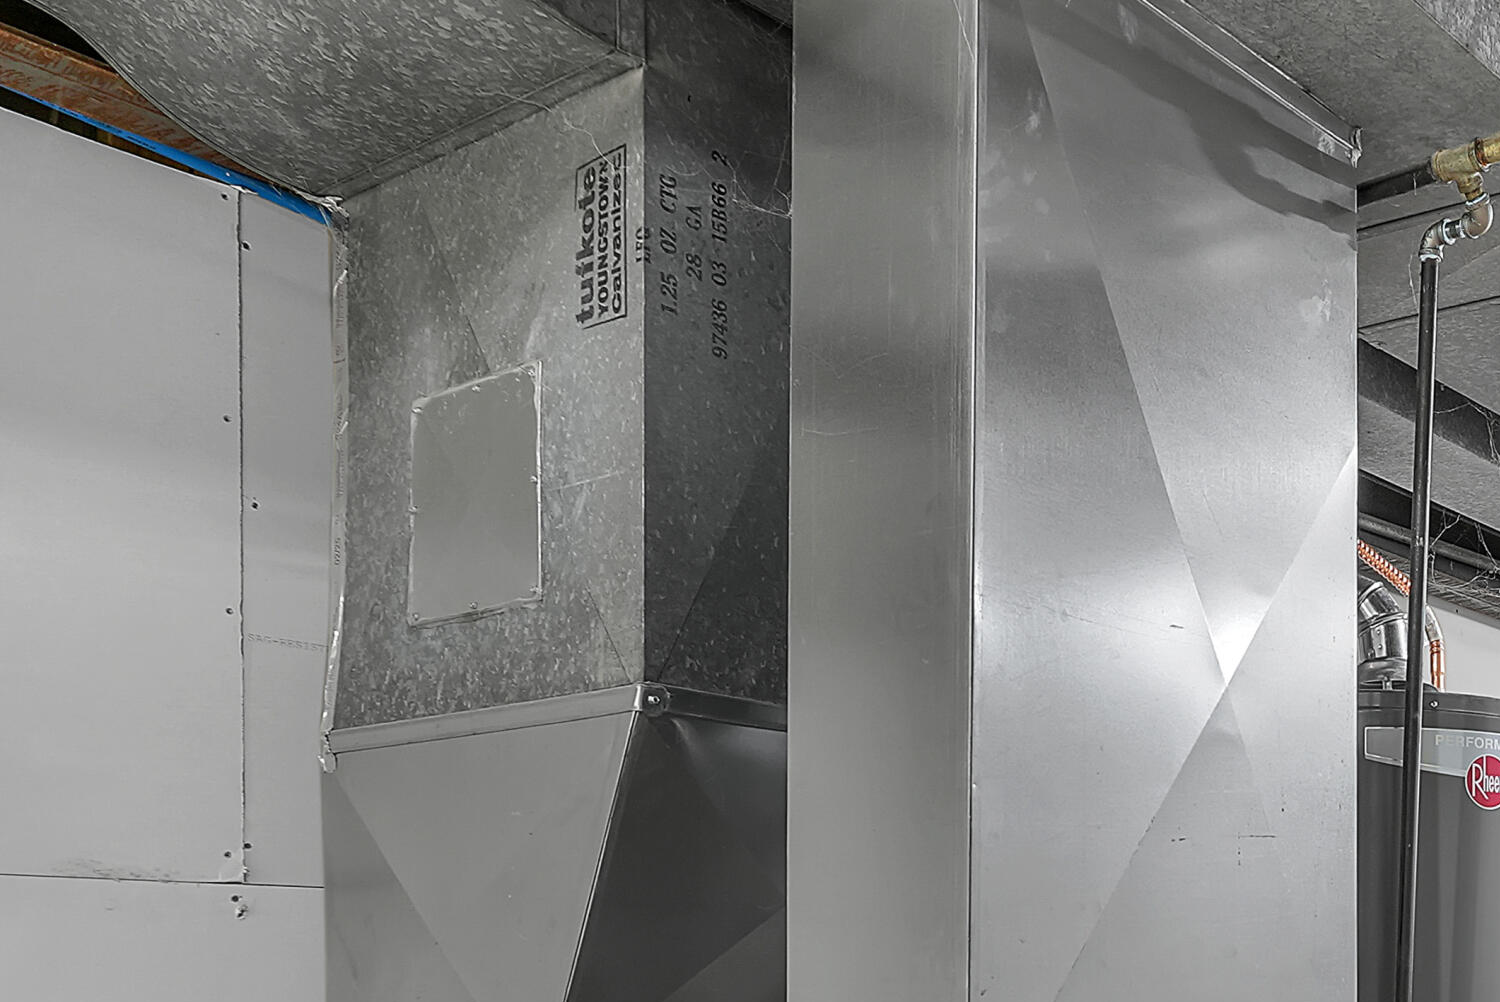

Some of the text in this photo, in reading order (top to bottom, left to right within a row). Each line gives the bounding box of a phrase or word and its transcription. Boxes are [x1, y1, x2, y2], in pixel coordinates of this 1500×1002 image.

[711, 150, 728, 167] 2
[597, 160, 609, 318] YOUNGSTOWN
[661, 226, 677, 254] OZ
[686, 253, 703, 282] 28
[711, 261, 728, 287] 03
[660, 272, 679, 316] 1.25
[711, 298, 729, 360] 97436
